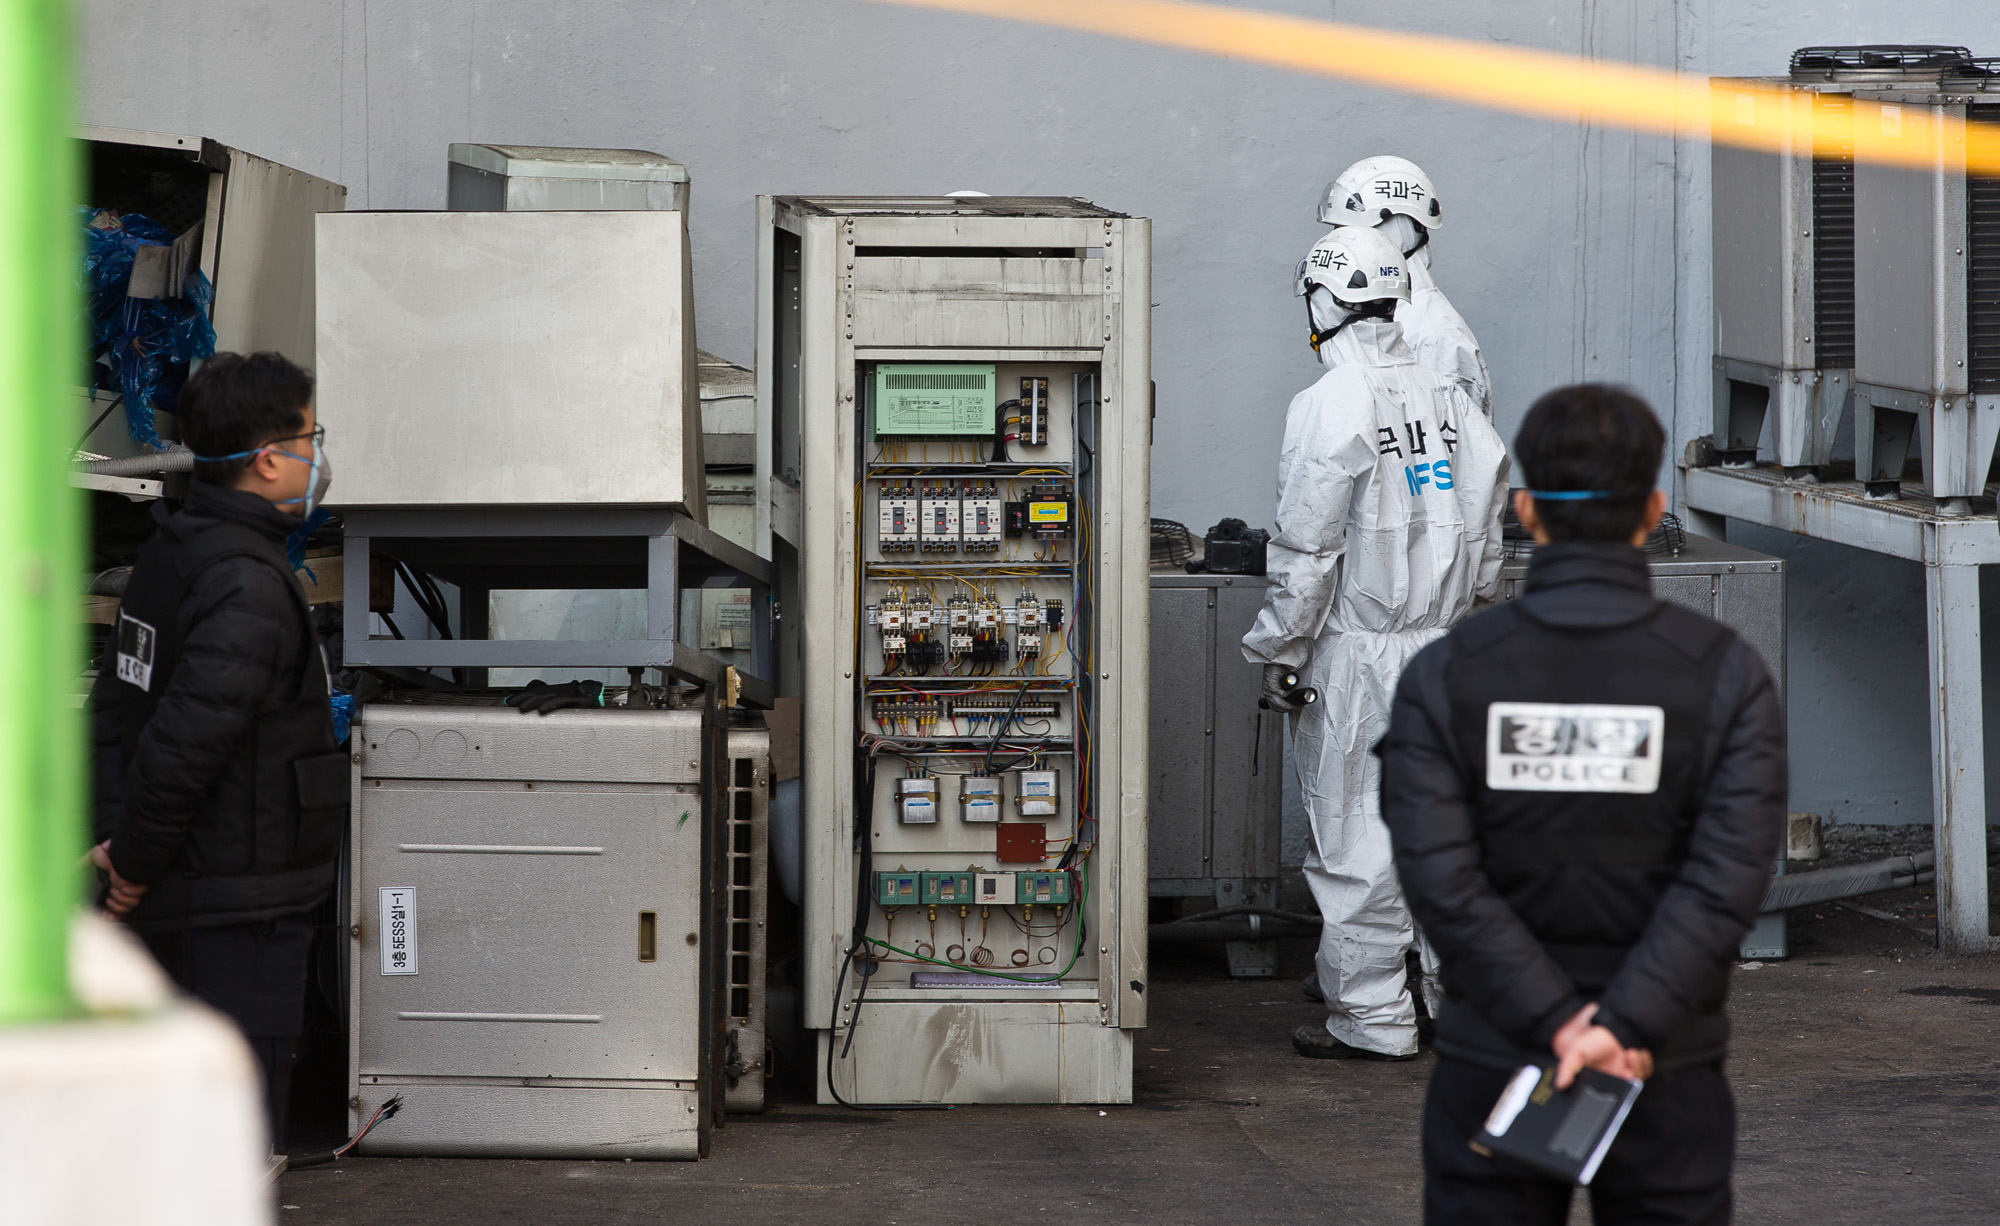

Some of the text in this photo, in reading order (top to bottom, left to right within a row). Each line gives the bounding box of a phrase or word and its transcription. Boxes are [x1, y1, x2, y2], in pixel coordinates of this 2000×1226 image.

[1374, 181, 1425, 201] 국과수
[1310, 249, 1349, 271] 국과수
[1379, 266, 1400, 277] NFS
[1404, 459, 1454, 497] NFS
[1511, 762, 1637, 783] POLICE
